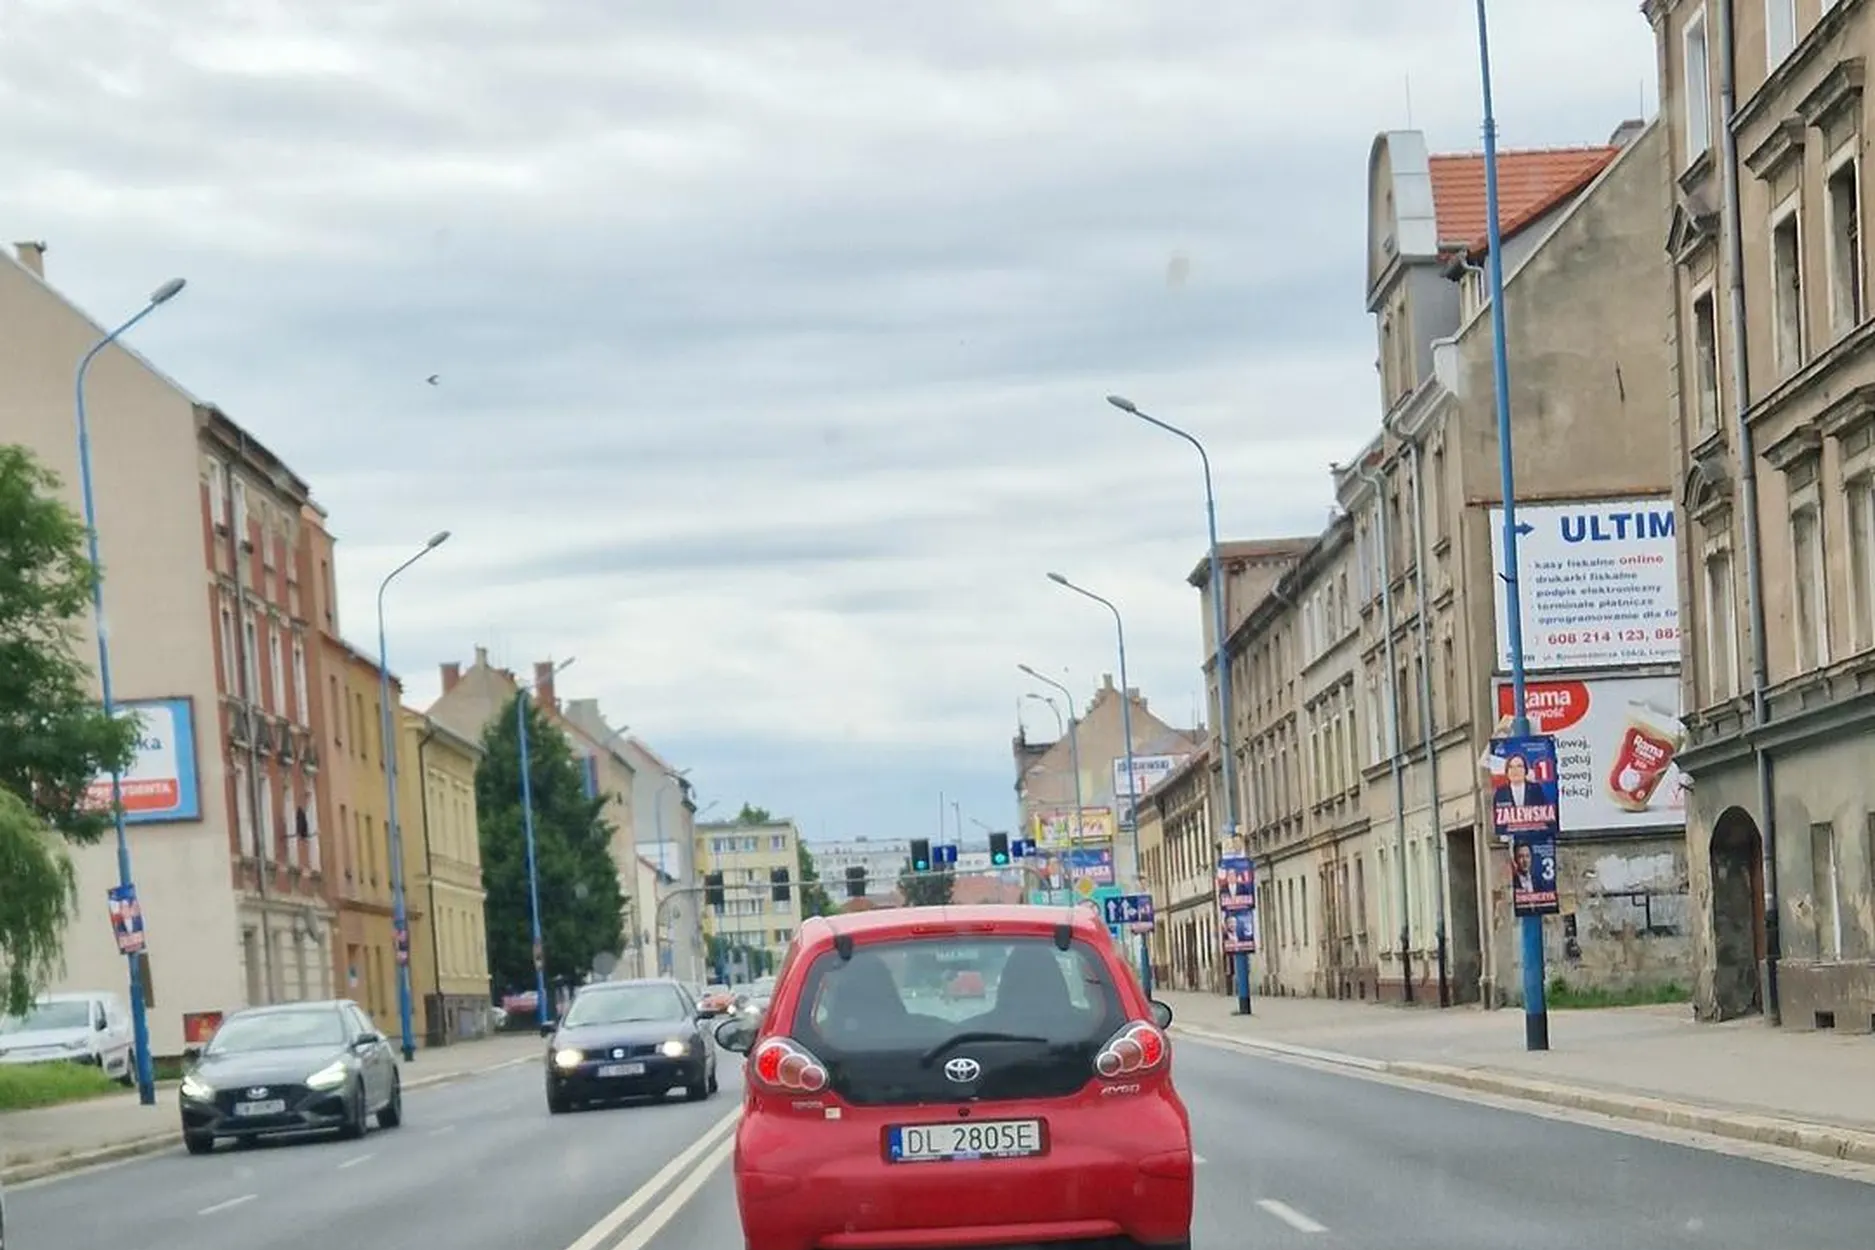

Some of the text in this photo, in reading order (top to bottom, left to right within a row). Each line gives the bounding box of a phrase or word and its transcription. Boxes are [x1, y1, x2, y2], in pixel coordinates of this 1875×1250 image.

[1561, 511, 1675, 543] ULTIM
[1567, 557, 1615, 568] fiskalne
[1619, 555, 1664, 566] online
[1535, 572, 1638, 584] drukarki fiskalne
[1536, 584, 1661, 598] podpis elektroniczny
[1537, 600, 1595, 610] terminale
[1538, 613, 1639, 625] oprogramowanie
[1642, 610, 1661, 619] dla
[1548, 633, 1577, 645] 608
[1583, 631, 1611, 643] 214
[1618, 629, 1649, 642] 123,
[1540, 761, 1548, 780] 1
[1496, 804, 1556, 825] ZALEWSKA
[1541, 857, 1555, 880] 3
[908, 1123, 1033, 1154] DL 2805E
